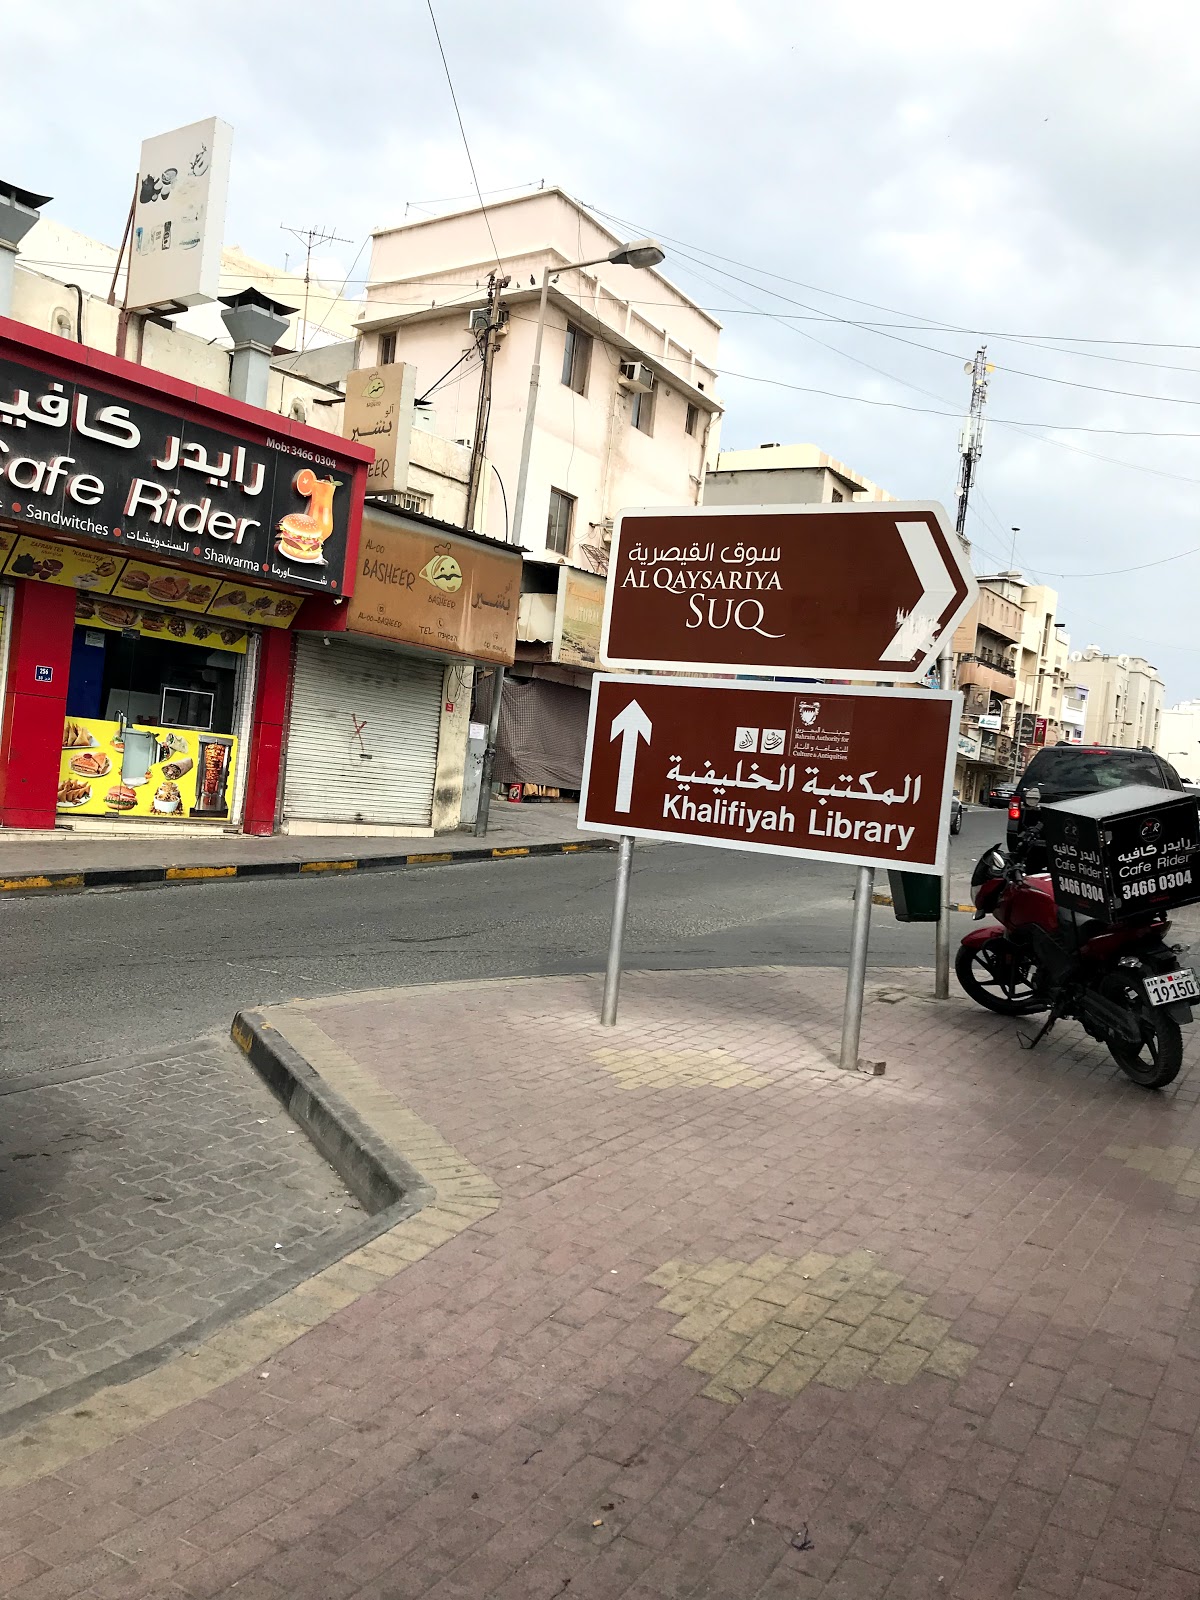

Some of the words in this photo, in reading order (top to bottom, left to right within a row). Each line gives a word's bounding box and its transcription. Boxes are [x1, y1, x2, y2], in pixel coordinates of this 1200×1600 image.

[0, 382, 141, 449] كافي
[351, 420, 393, 441] بشير
[156, 435, 265, 496] رايدر
[266, 437, 290, 454] Mob:
[291, 448, 313, 462] 3466
[314, 454, 337, 469] 0304
[26, 504, 109, 536] Sandwitches
[127, 478, 261, 545] Rider
[126, 530, 189, 553] السندويشات
[628, 542, 714, 567] القيصرية
[720, 542, 781, 567] سوق
[204, 548, 260, 572] Shawarma
[362, 558, 416, 592] BASHEER
[653, 567, 784, 595] QAYSARIYA
[685, 593, 786, 639] SUQ
[665, 754, 796, 795] الخليفية
[801, 767, 922, 807] المكتبة
[662, 793, 796, 834] Khalifiyah
[808, 808, 916, 851] Library
[1053, 843, 1078, 857] كافيه
[1080, 850, 1100, 865] رايدر
[1117, 844, 1158, 863] كافيه
[1055, 858, 1076, 872] Cafe
[1078, 863, 1103, 879] Rider
[1119, 862, 1152, 878] Cafe
[1157, 854, 1193, 869] Rider
[1059, 876, 1080, 896] 3466
[1081, 882, 1105, 903] 0304
[1122, 879, 1156, 900] 3466
[1158, 870, 1193, 891] 0304
[1152, 980, 1196, 1004] 19150
